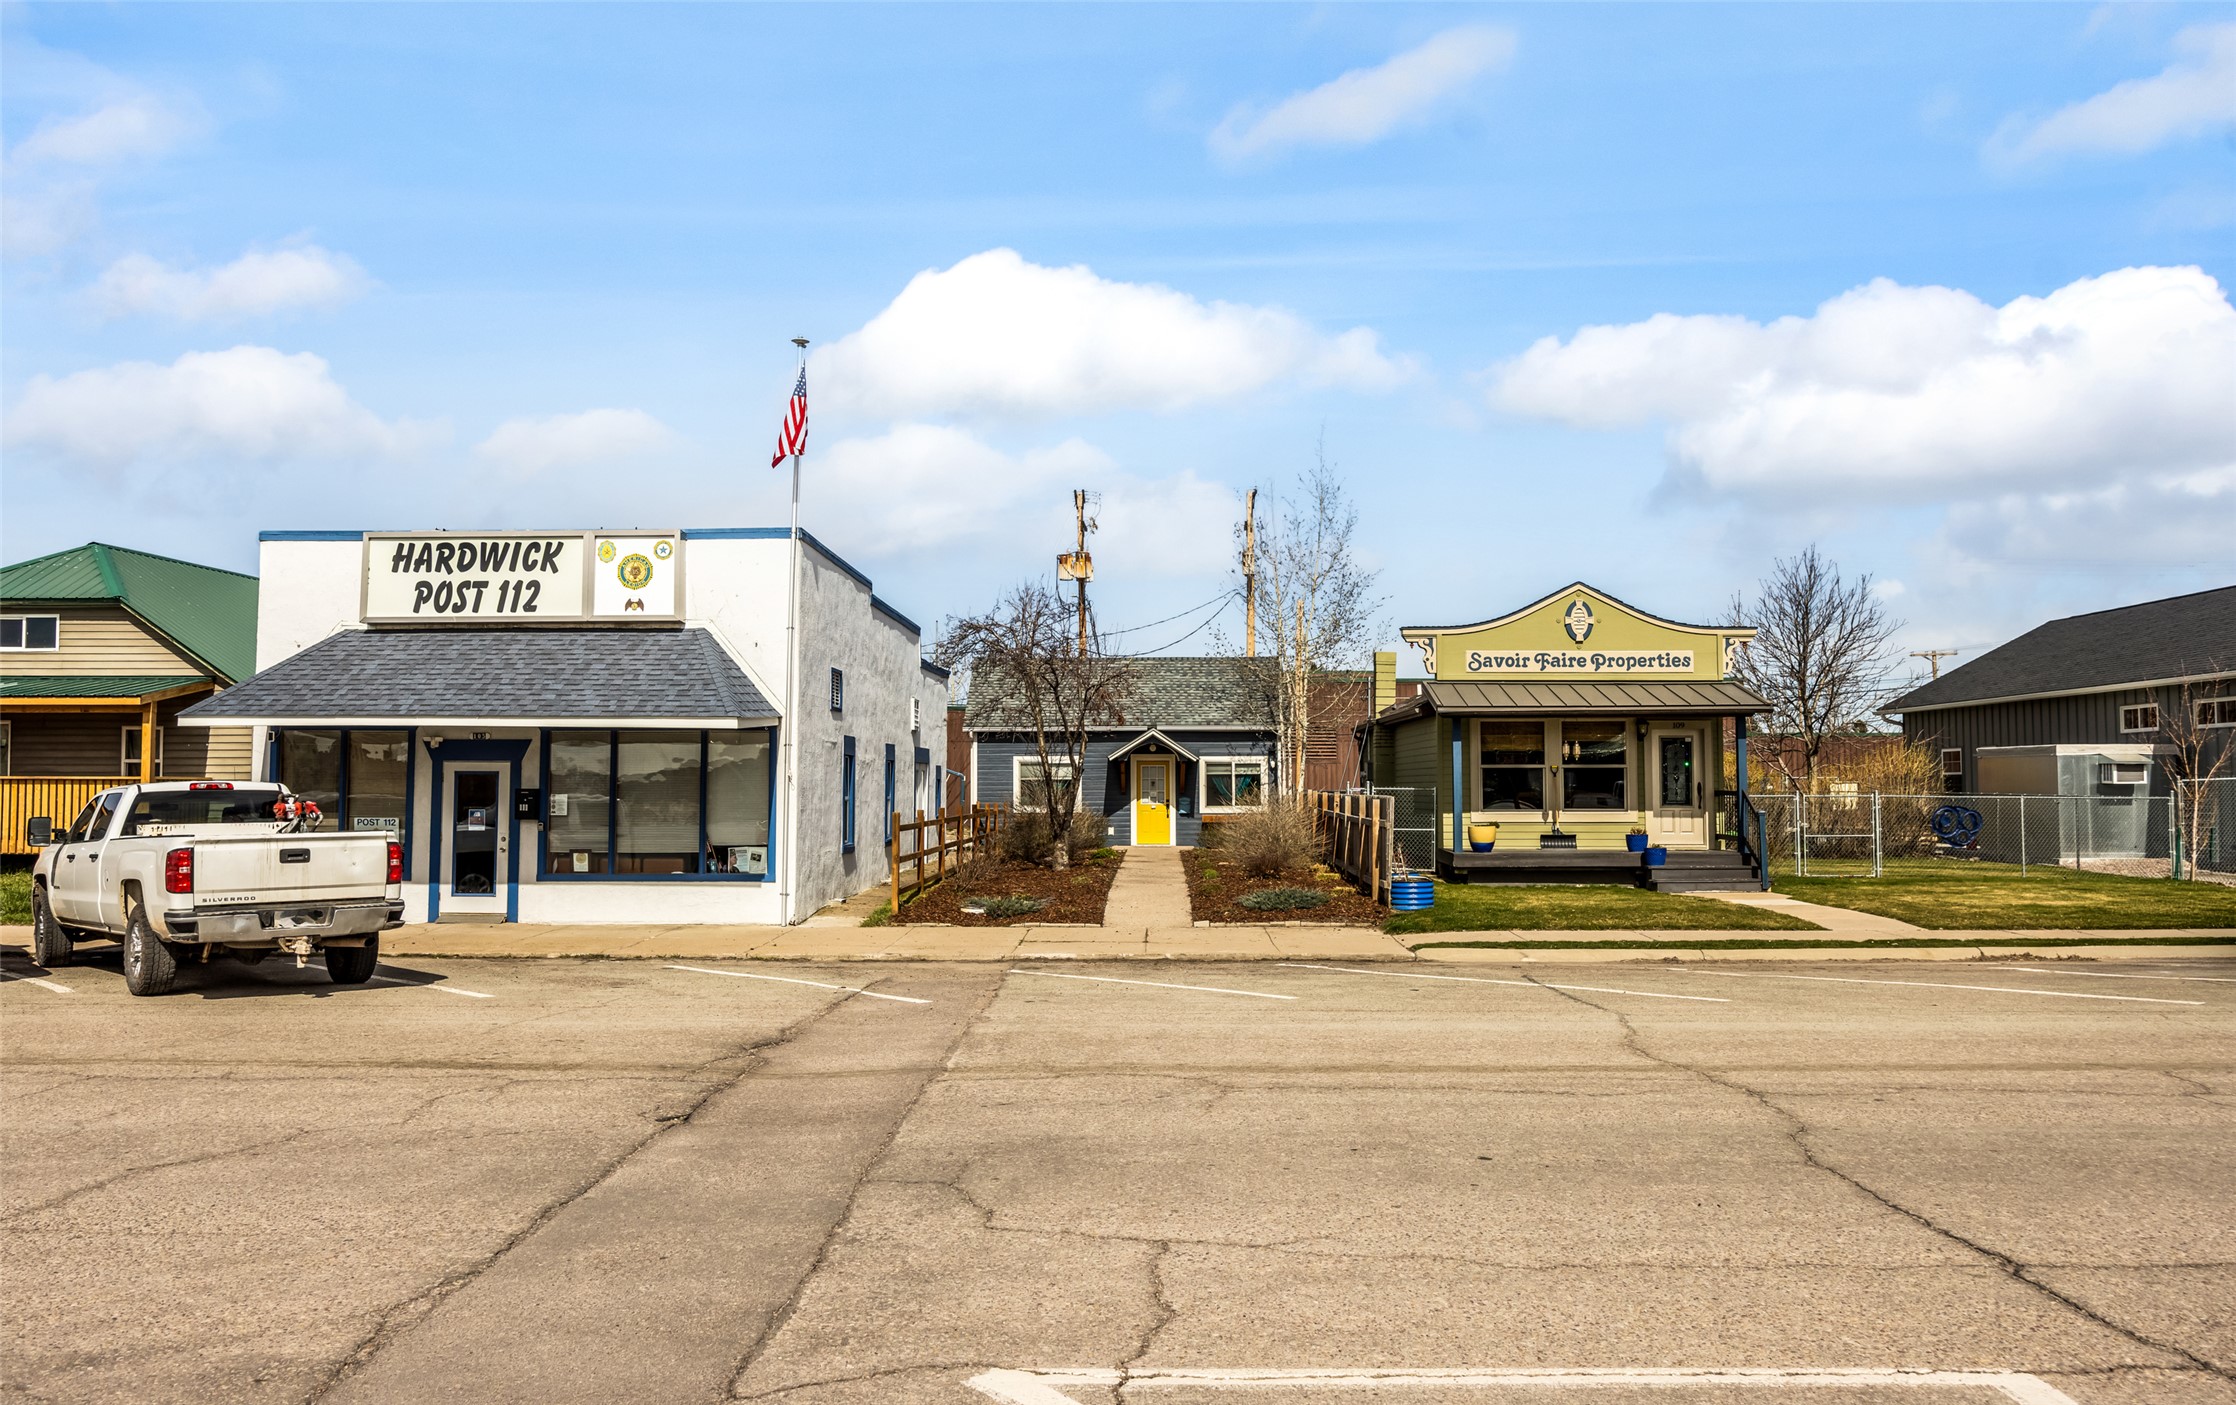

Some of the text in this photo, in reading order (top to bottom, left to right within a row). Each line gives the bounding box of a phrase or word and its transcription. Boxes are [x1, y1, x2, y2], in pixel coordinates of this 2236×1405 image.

[391, 541, 564, 576] HARDWICK
[412, 579, 541, 614] POST 112
[1468, 652, 1691, 671] Savoir Faire Properties
[1672, 721, 1685, 729] 109
[356, 818, 396, 826] POST 112
